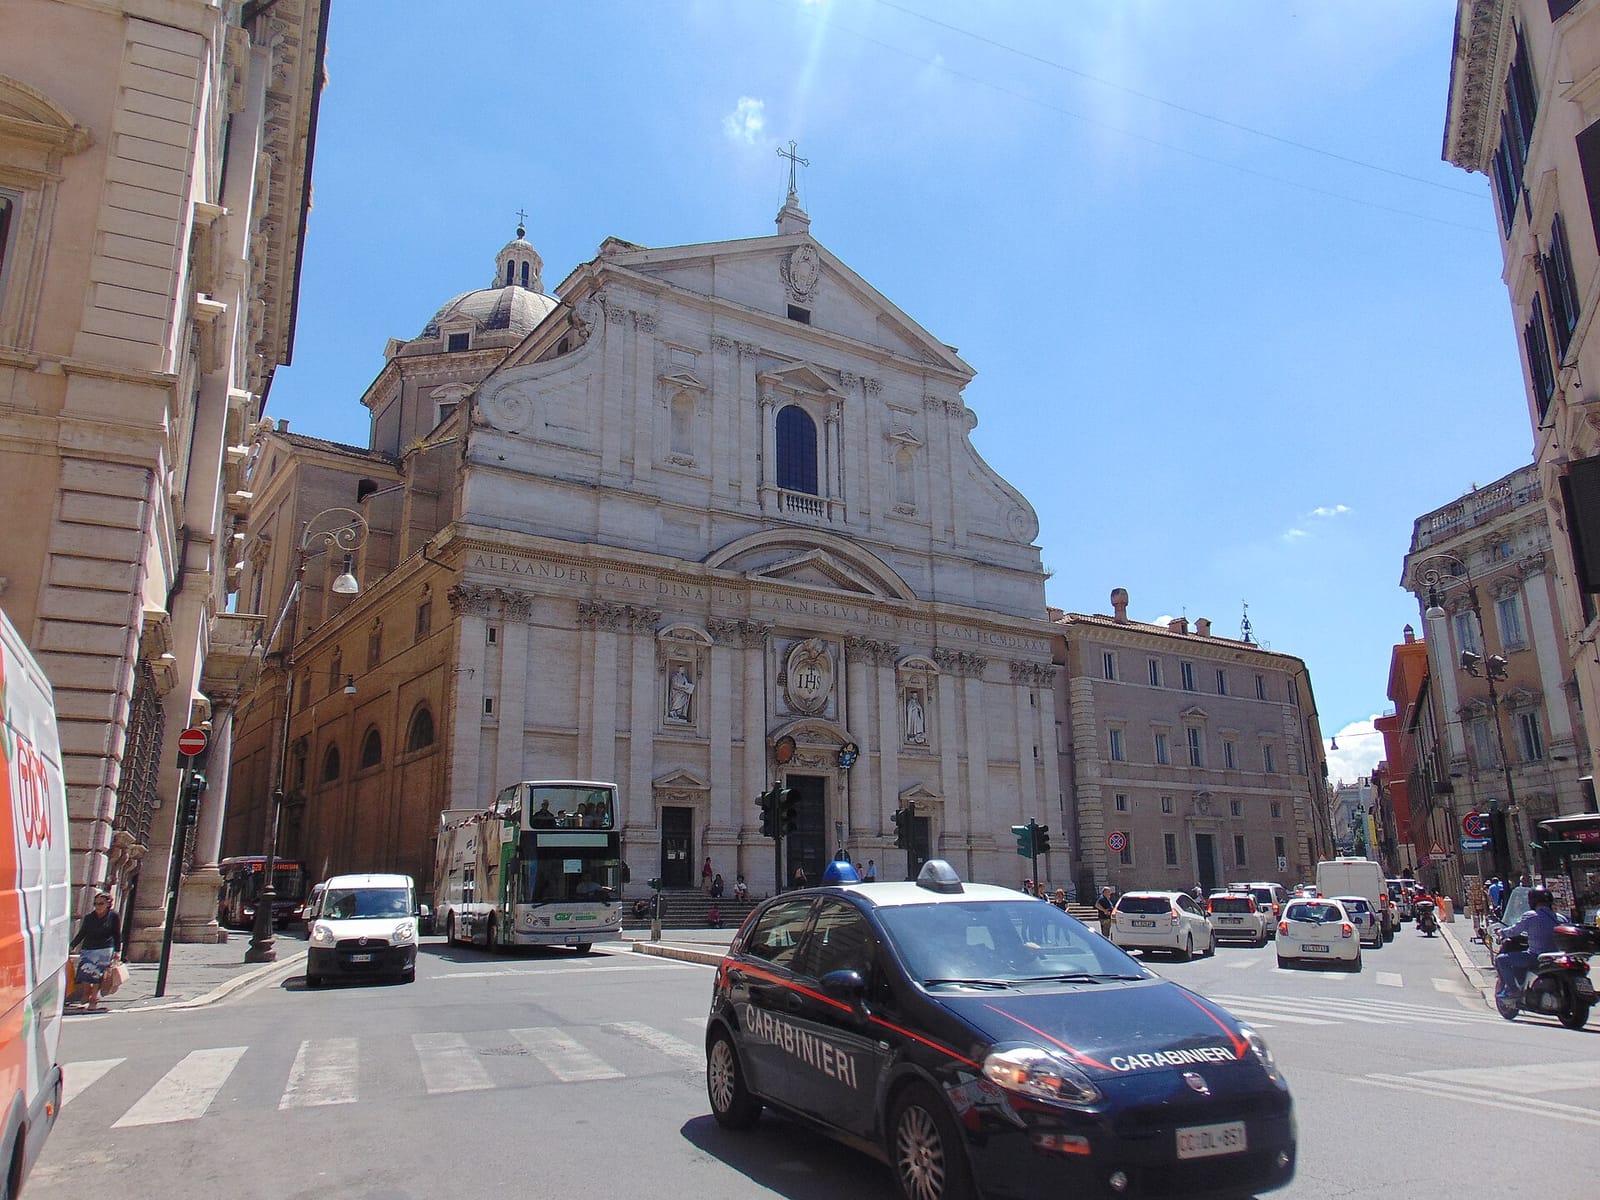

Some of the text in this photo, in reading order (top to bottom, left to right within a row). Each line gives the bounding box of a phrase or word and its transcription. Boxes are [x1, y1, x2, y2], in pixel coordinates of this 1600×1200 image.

[474, 554, 588, 583] ALEXANDER
[604, 572, 743, 605] CARDINALIS
[761, 594, 859, 620] FARNESIVS
[797, 673, 821, 690] IHS
[745, 1002, 857, 1090] CARABINIERI
[1110, 1046, 1237, 1072] CARABINIERI
